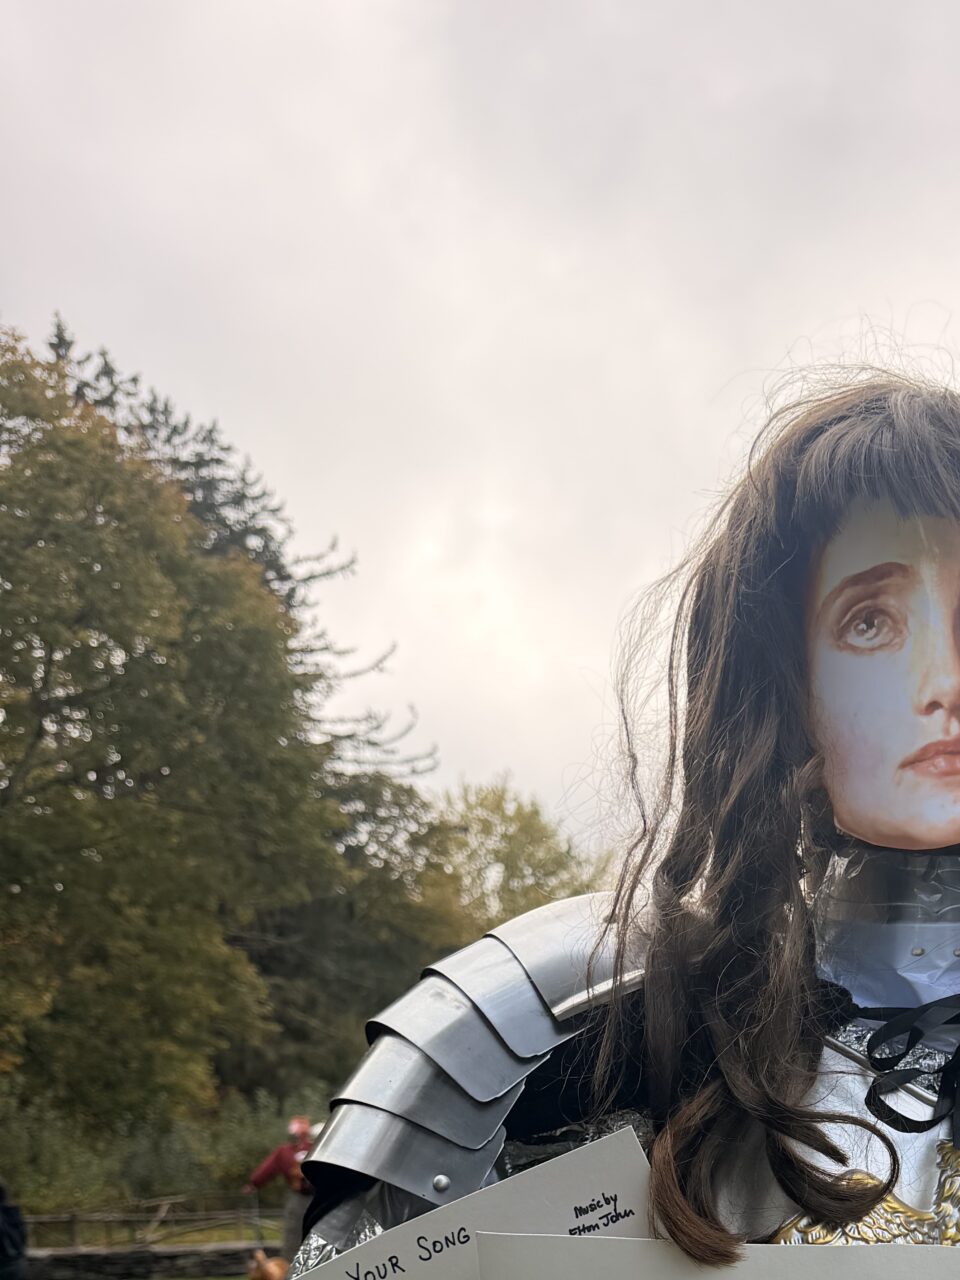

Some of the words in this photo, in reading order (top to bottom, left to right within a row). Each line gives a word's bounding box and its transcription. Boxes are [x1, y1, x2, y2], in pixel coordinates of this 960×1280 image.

[573, 1198, 604, 1219] Music
[601, 1192, 618, 1214] by
[568, 1223, 600, 1236] Elton
[598, 1208, 635, 1227] John
[417, 1226, 471, 1262] SONG
